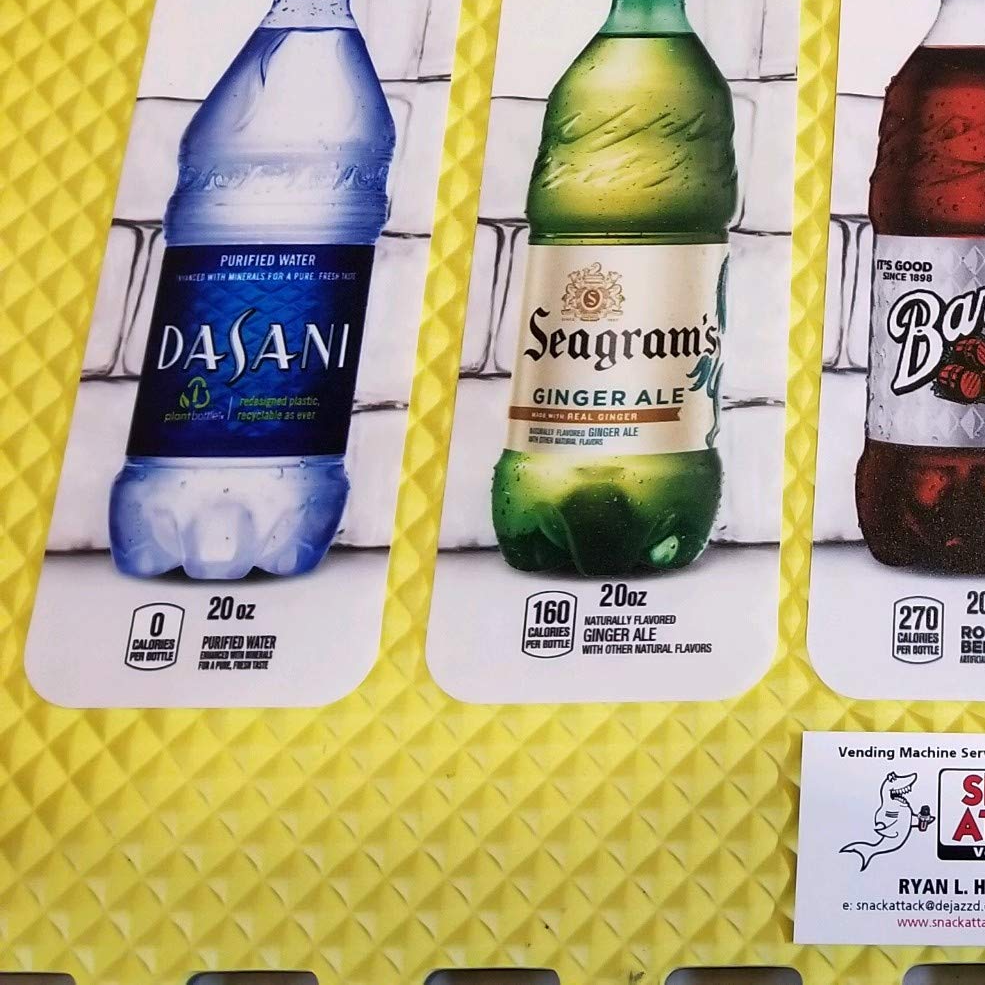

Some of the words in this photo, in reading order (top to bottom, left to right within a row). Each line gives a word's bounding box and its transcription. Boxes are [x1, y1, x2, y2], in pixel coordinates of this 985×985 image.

[220, 255, 274, 266] PURIFIED
[279, 254, 316, 265] WATER
[877, 260, 892, 271] IT'S
[895, 261, 932, 272] GOOD
[883, 273, 907, 281] SINCE
[909, 273, 932, 282] 1898
[524, 307, 718, 371] Seagram's
[157, 311, 350, 388] DASANI
[240, 396, 286, 408] redesigned
[289, 396, 320, 407] plastic,
[533, 388, 625, 406] GINGER
[635, 388, 685, 405] ALE
[237, 410, 281, 422] recyclable
[598, 413, 638, 421] GINGER
[589, 427, 619, 437] GINGER
[623, 427, 639, 436] ALE
[207, 596, 234, 620] 20
[236, 604, 256, 620] oz
[533, 600, 570, 624] 160
[584, 616, 631, 625] NATURALLY
[634, 615, 676, 624] FLAVORED
[899, 606, 939, 630] 270
[150, 613, 165, 637] 0
[528, 627, 570, 637] CALORIES
[584, 628, 629, 642] GINGER
[633, 628, 656, 641] ALE
[898, 633, 939, 643] CALORIES
[132, 639, 175, 650] CALORIES
[202, 636, 244, 649] PURIFIED
[246, 636, 276, 649] WATER
[526, 640, 541, 649] PER
[543, 640, 570, 648] BOTTLE
[582, 645, 603, 654] WITH
[605, 645, 632, 654] OTHER
[635, 644, 673, 654] NATURAL
[675, 643, 712, 653] FLAVORS
[838, 747, 895, 760] Vending
[900, 747, 957, 759] Machine
[899, 879, 948, 895] RYAN
[954, 879, 968, 895] L.
[842, 903, 852, 911] e:
